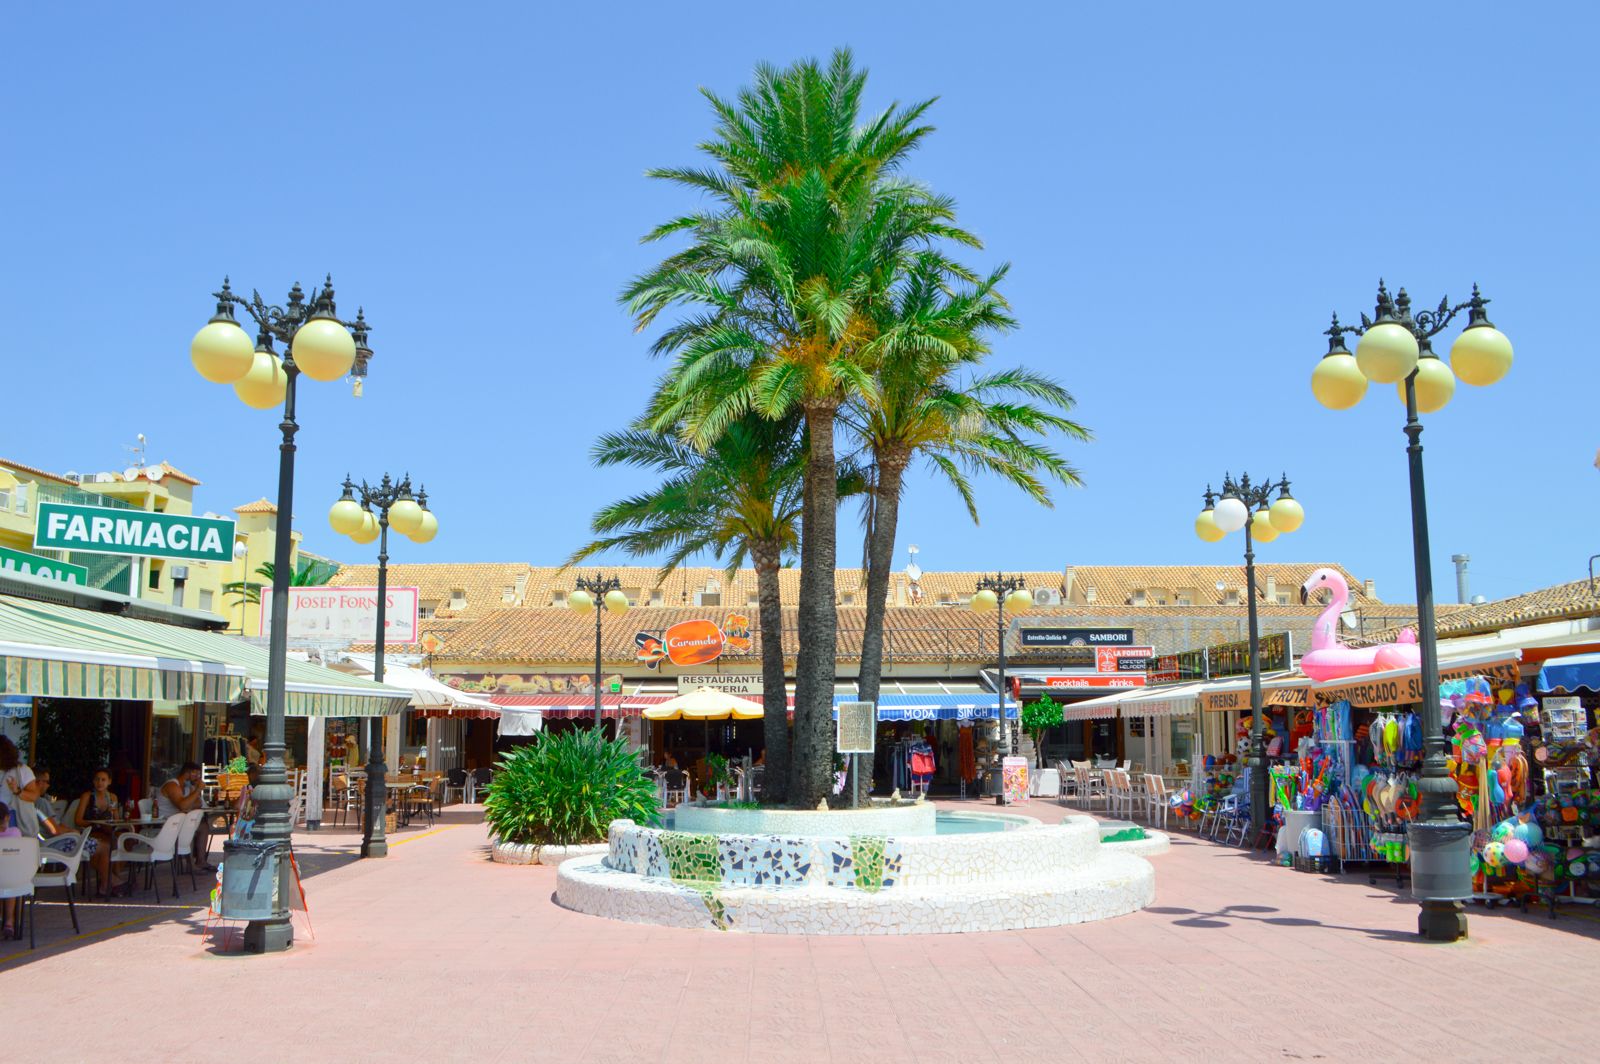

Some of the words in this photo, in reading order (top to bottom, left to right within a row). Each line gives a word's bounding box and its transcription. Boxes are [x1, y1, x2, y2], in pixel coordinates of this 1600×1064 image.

[46, 512, 224, 554] FARMACIA
[294, 595, 336, 611] JOSEP
[338, 594, 394, 610] FORNS
[669, 634, 717, 648] Caramelo
[1089, 633, 1128, 642] SAMBORI
[1113, 649, 1121, 657] LA
[1122, 649, 1151, 657] FONTETA
[682, 676, 764, 684] RESTAURANTE
[1109, 679, 1134, 687] drinks
[1209, 694, 1239, 709] PRENSA
[1270, 688, 1309, 704] FRUTA
[903, 709, 936, 719] MODA
[957, 707, 988, 718] SINGH
